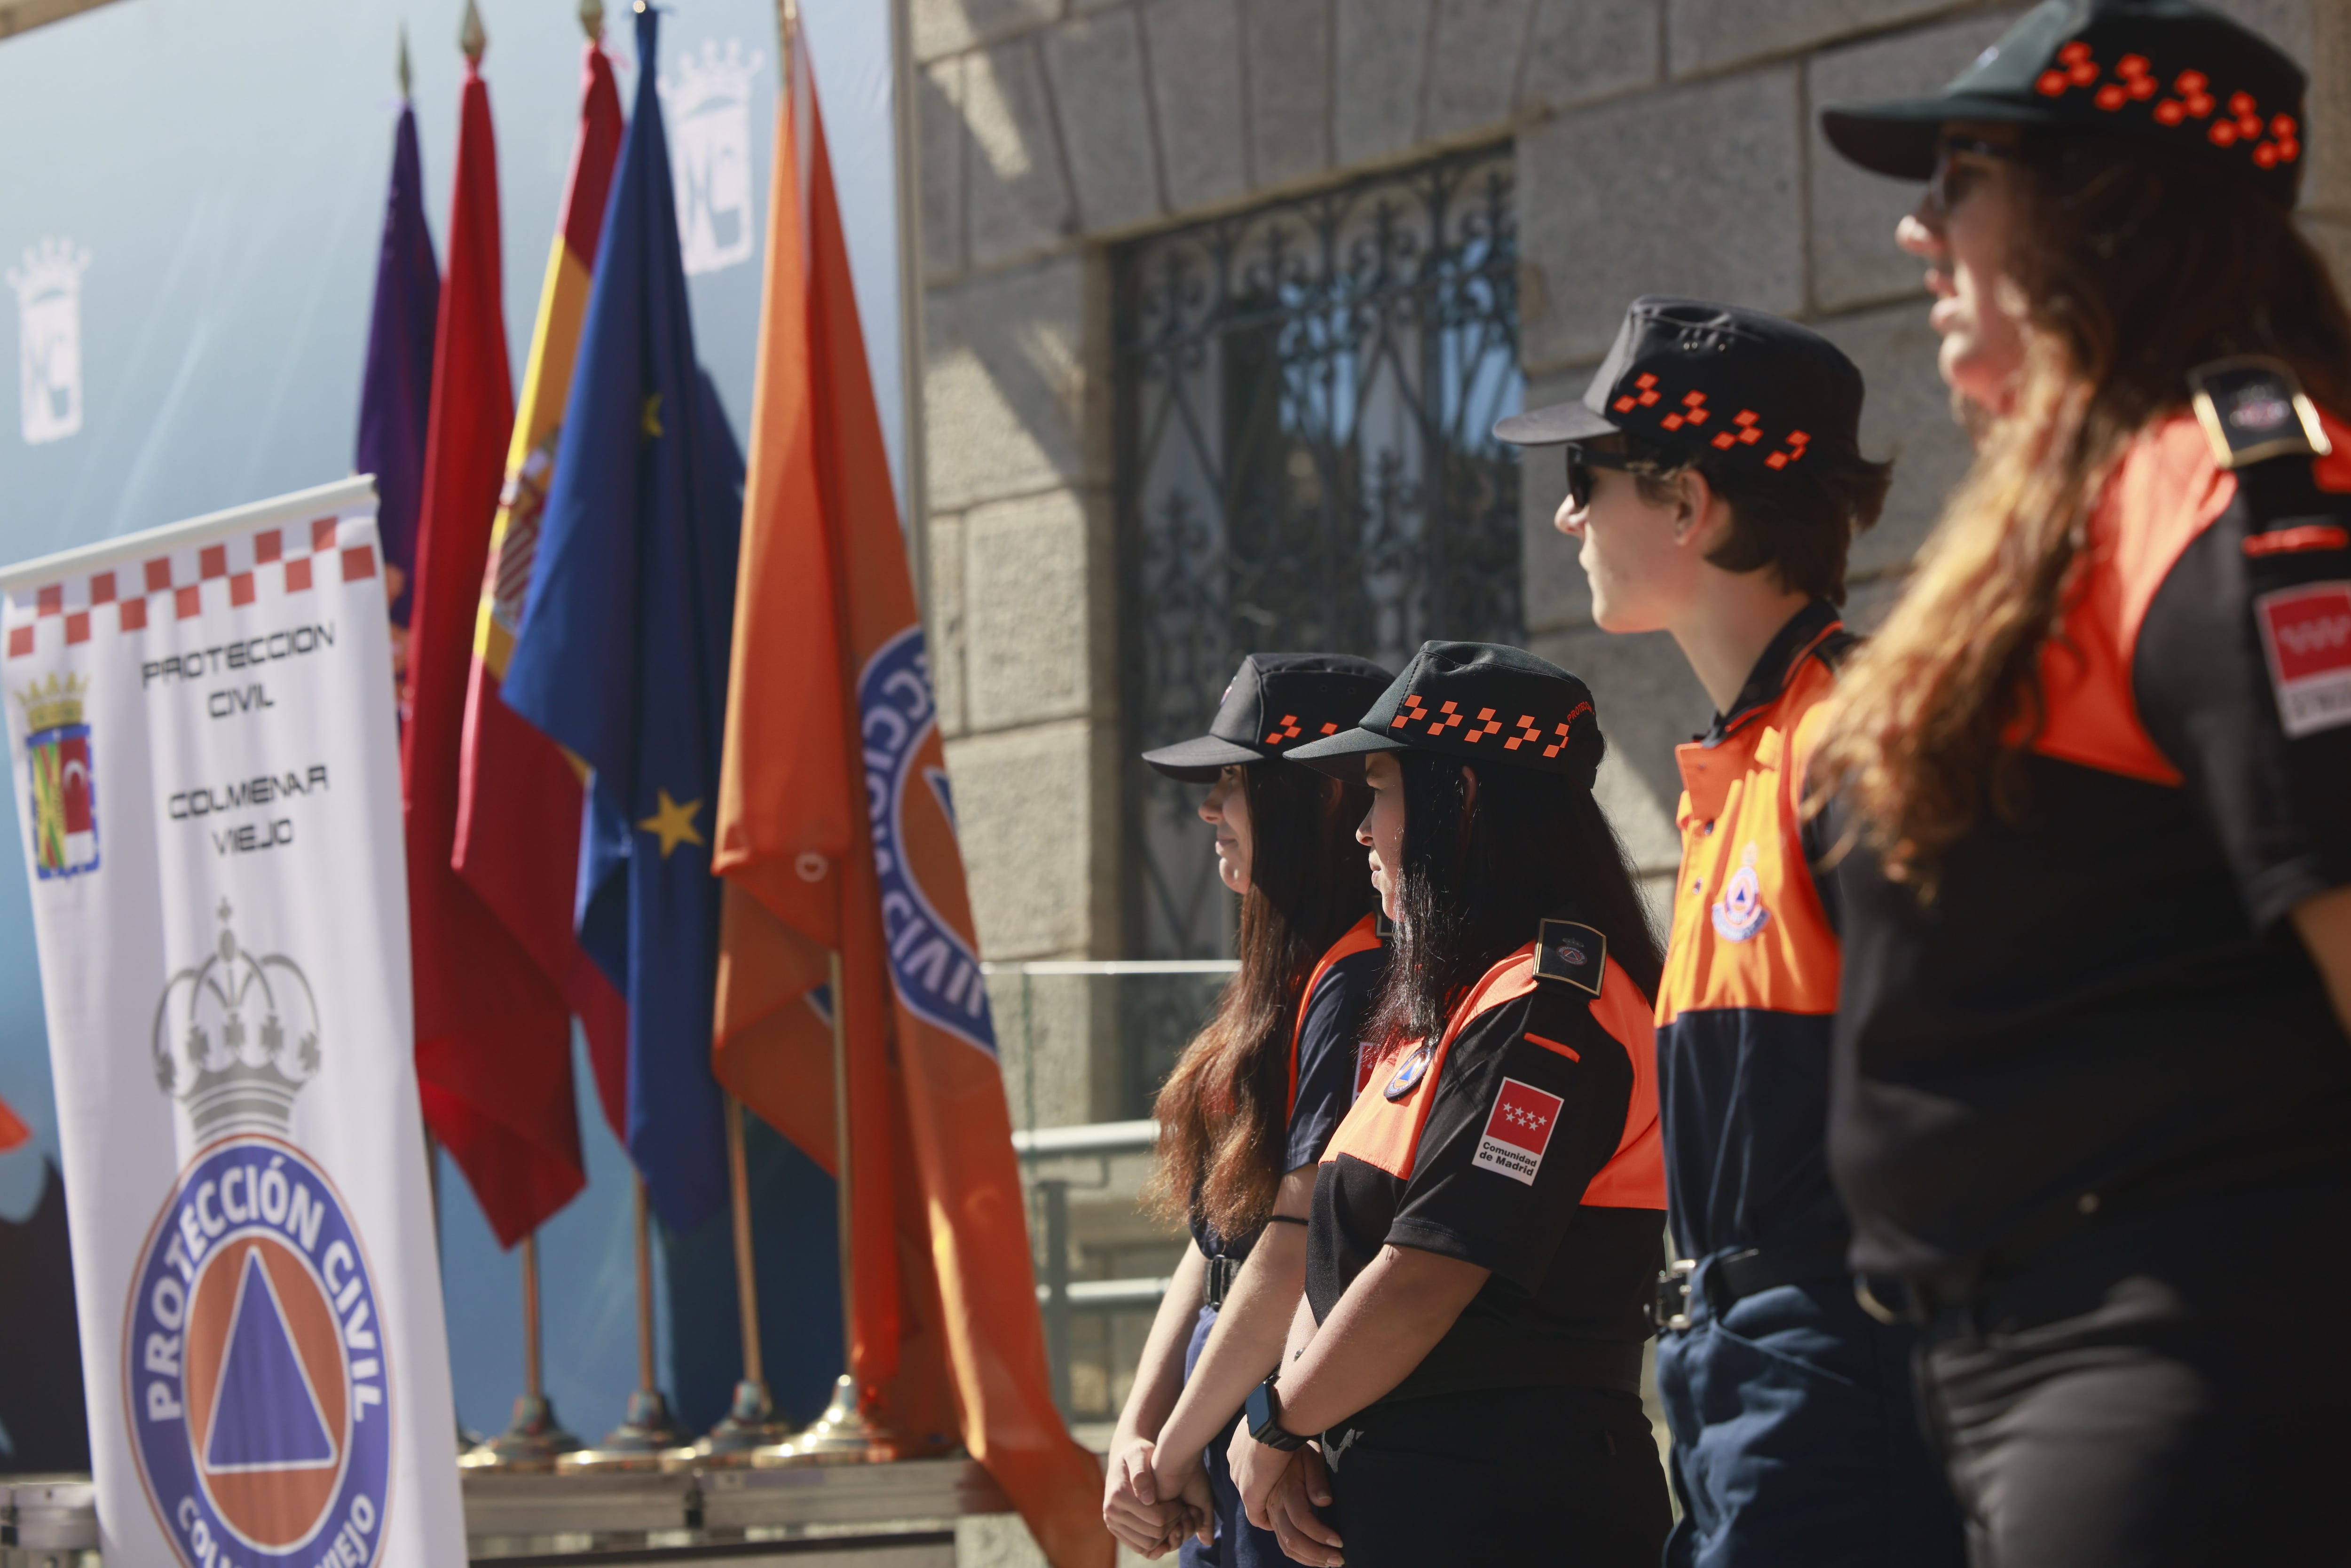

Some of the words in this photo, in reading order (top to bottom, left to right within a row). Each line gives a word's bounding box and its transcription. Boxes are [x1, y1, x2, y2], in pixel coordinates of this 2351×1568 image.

[142, 623, 334, 688] PROTECCION
[209, 683, 275, 719] CIVIL
[170, 765, 328, 819] COLMENAR
[212, 819, 292, 855] VIEJO
[1480, 1151, 1493, 1161] de
[1496, 1156, 1534, 1176] Madrid
[1483, 1142, 1537, 1167] Comunidad
[144, 1156, 324, 1422] PROTECCIÓN
[323, 1240, 381, 1422] CIVIL
